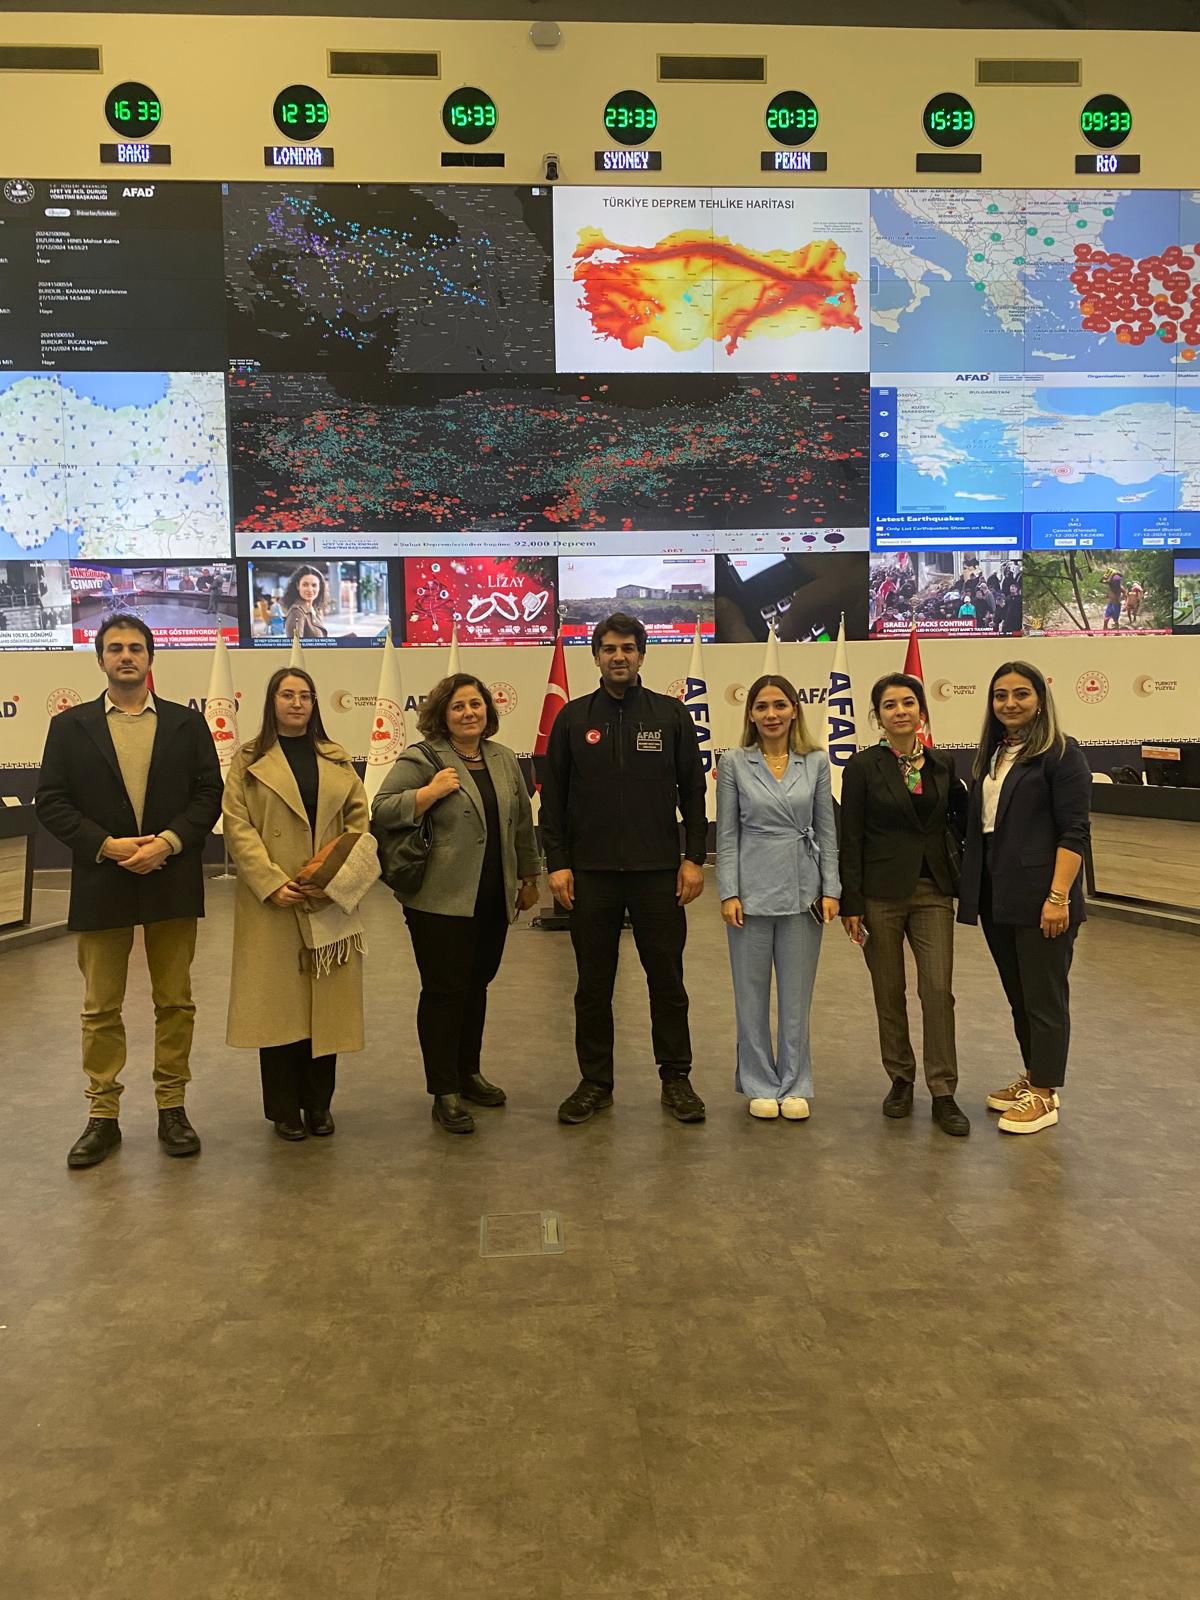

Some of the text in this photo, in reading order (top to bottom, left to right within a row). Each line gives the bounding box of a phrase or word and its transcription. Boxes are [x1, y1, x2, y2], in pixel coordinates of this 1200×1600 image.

[451, 106, 496, 126] 15:33
[605, 108, 656, 128] 23:33
[767, 109, 817, 128] 20:33
[931, 111, 973, 130] 15:33
[1081, 112, 1131, 131] 09:33
[273, 147, 322, 165] LONDRA
[603, 151, 649, 169] SYDNEY
[122, 187, 154, 198] AFAD
[603, 196, 795, 209] TÜRKİYE DEPREM TEHLİKE HARİTASI
[955, 373, 990, 382] AFAD
[251, 540, 306, 549] AFAD
[553, 540, 596, 548] Deprem
[828, 671, 858, 767] AFAD
[637, 731, 661, 739] AFAD
